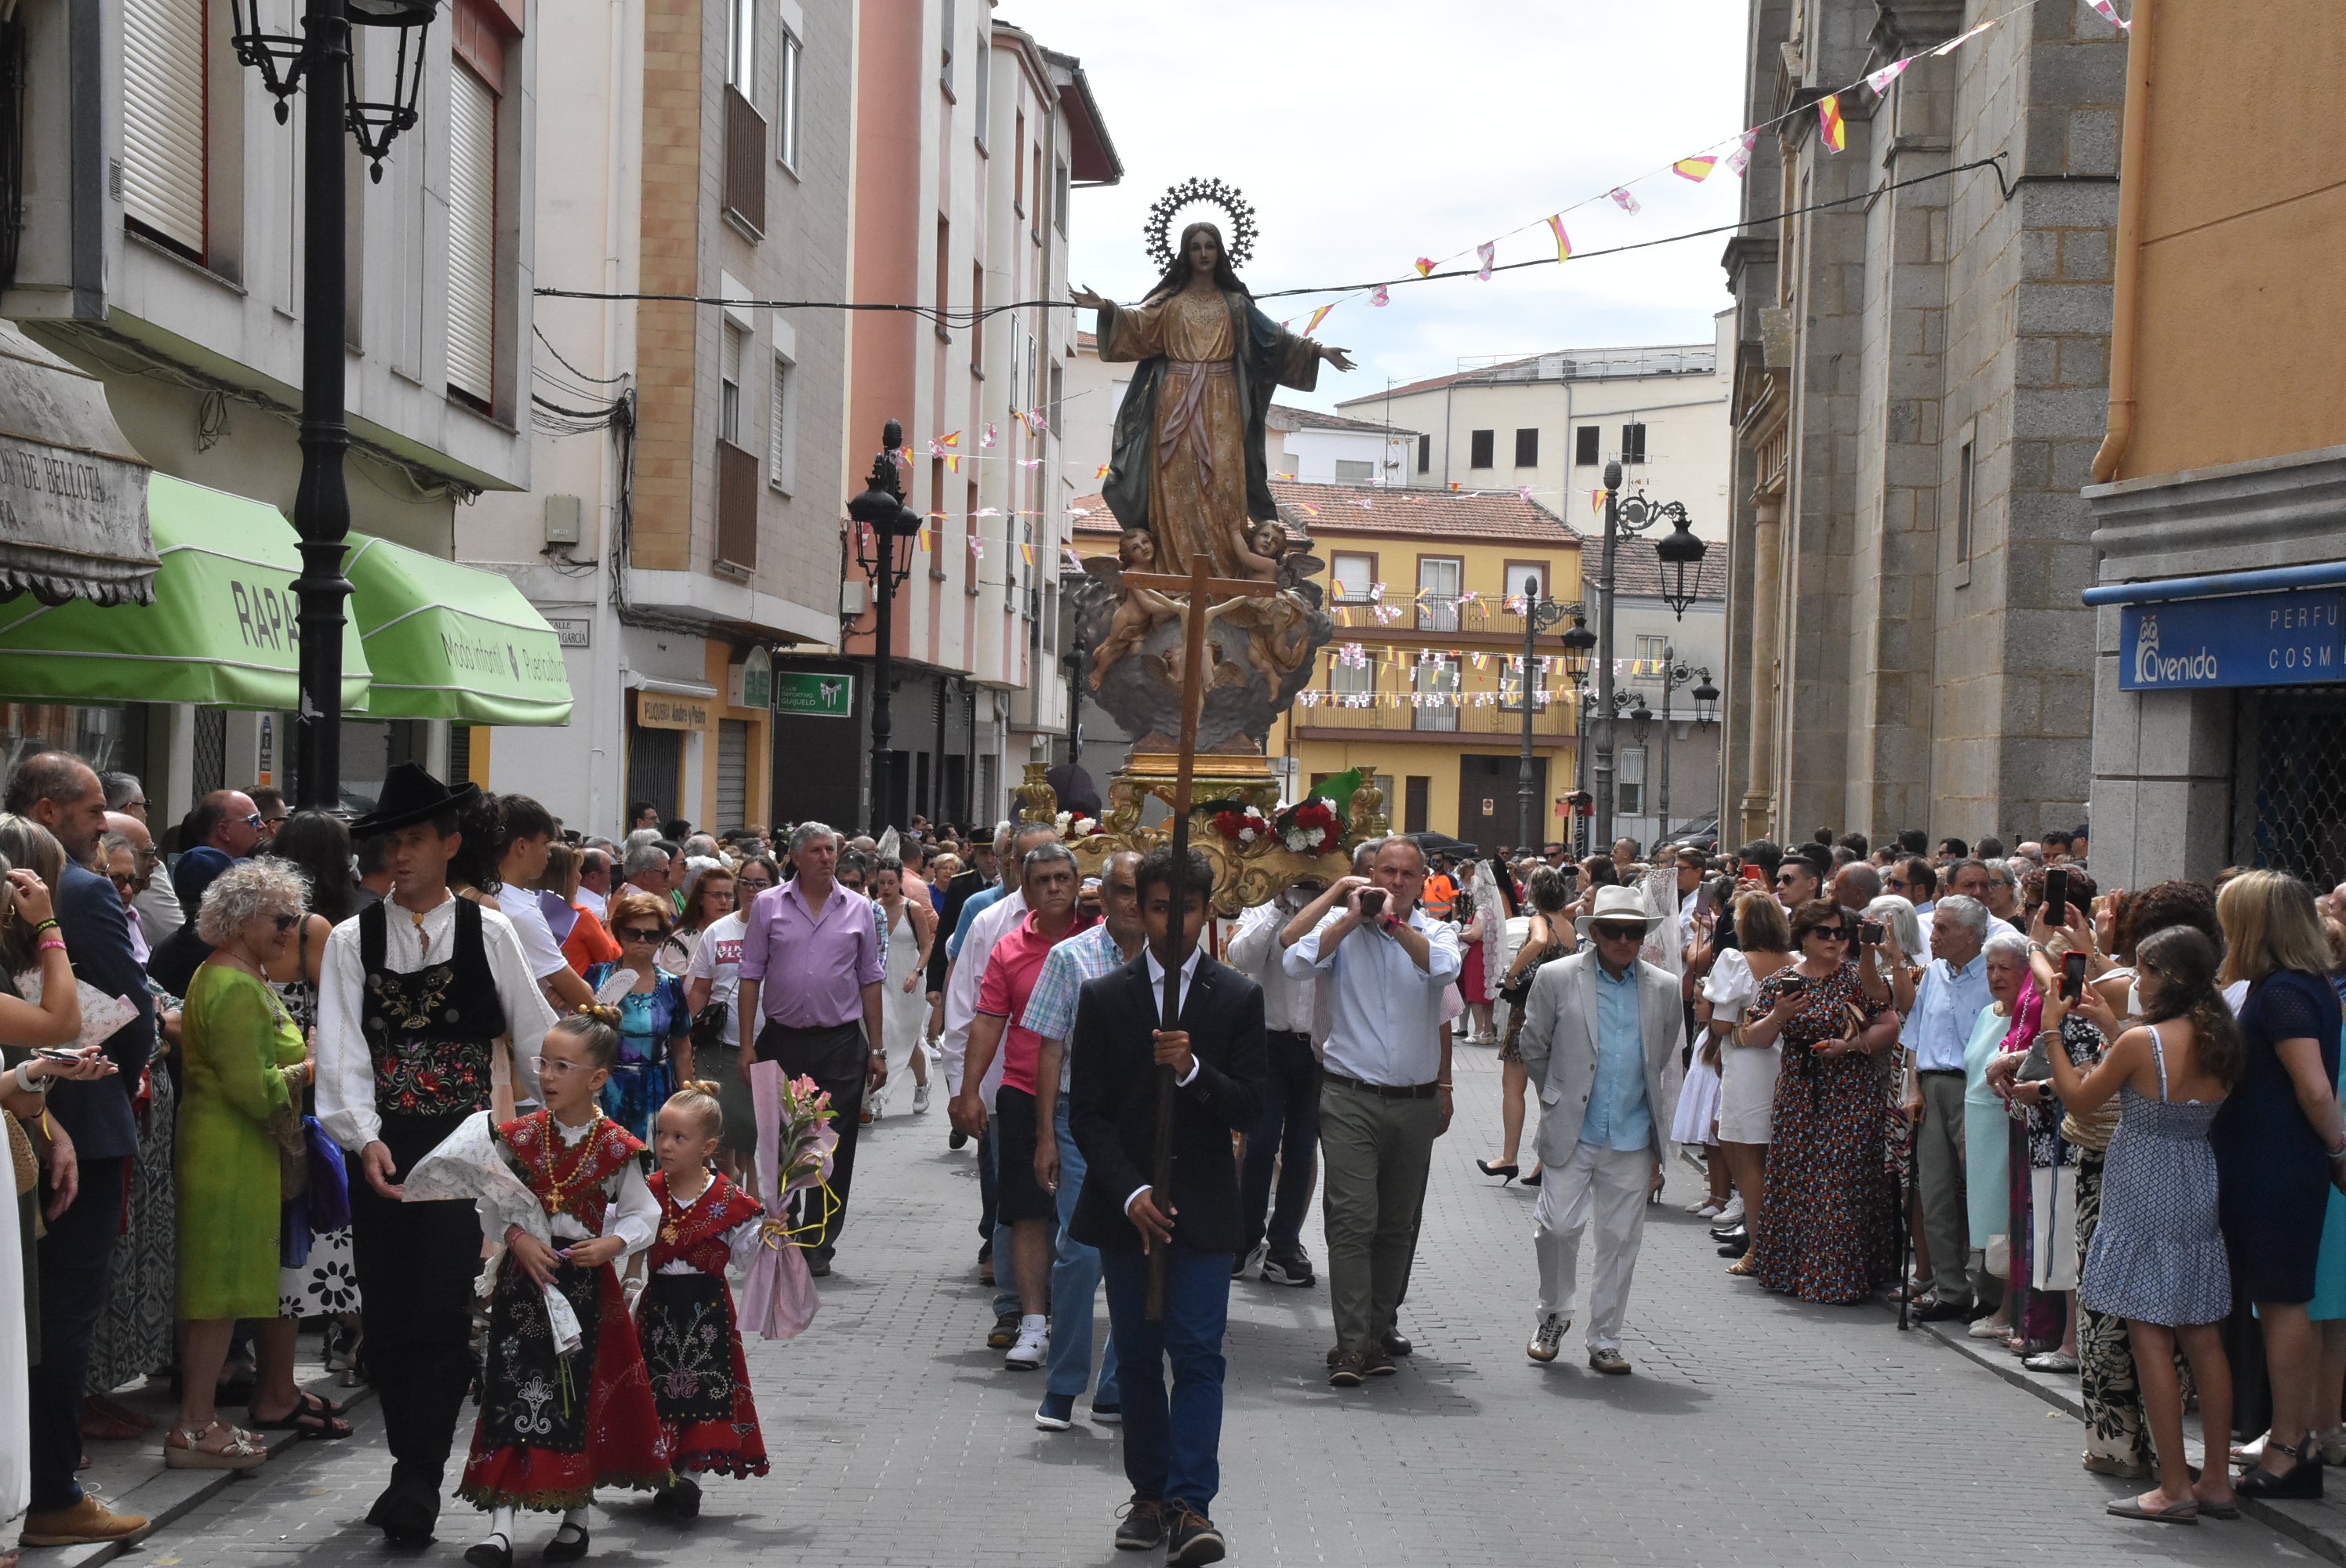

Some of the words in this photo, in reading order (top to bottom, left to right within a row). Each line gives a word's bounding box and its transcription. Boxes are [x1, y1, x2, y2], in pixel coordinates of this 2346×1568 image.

[18, 449, 41, 492] DE
[43, 456, 106, 503] BELLOTA
[231, 580, 300, 653] RAPA
[2270, 604, 2337, 630] PERFU
[441, 632, 474, 670] Moda
[562, 630, 586, 644] GARCÍA
[522, 648, 568, 683] Puericultura
[2269, 644, 2346, 669] COSM
[781, 697, 816, 706] GUIJUELO
